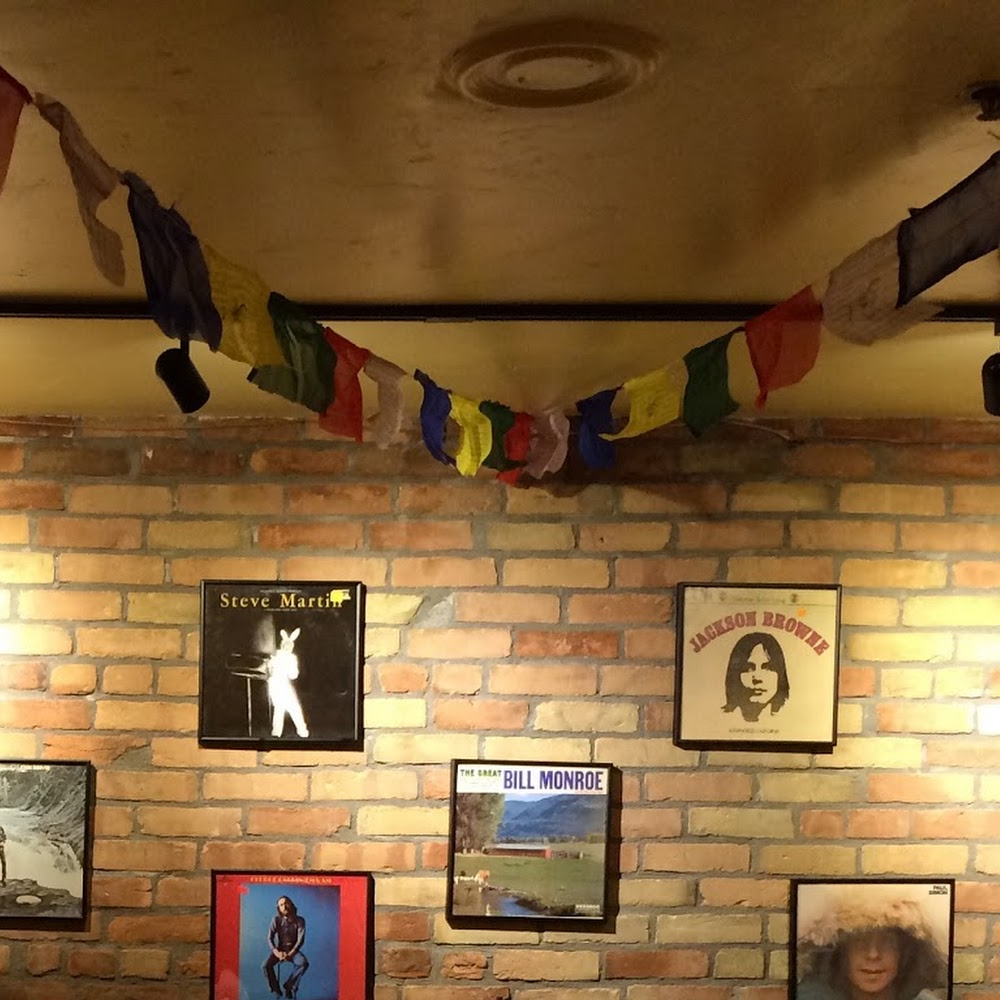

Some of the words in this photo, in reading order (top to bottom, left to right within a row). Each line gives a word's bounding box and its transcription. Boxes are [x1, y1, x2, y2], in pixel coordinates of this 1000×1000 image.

[220, 593, 270, 608] Steve
[689, 610, 757, 653] JACKSON
[762, 611, 830, 656] BROWNE
[460, 769, 475, 777] THE
[478, 769, 502, 778] GREAT
[504, 770, 535, 790] BILL
[540, 770, 604, 791] MONROE
